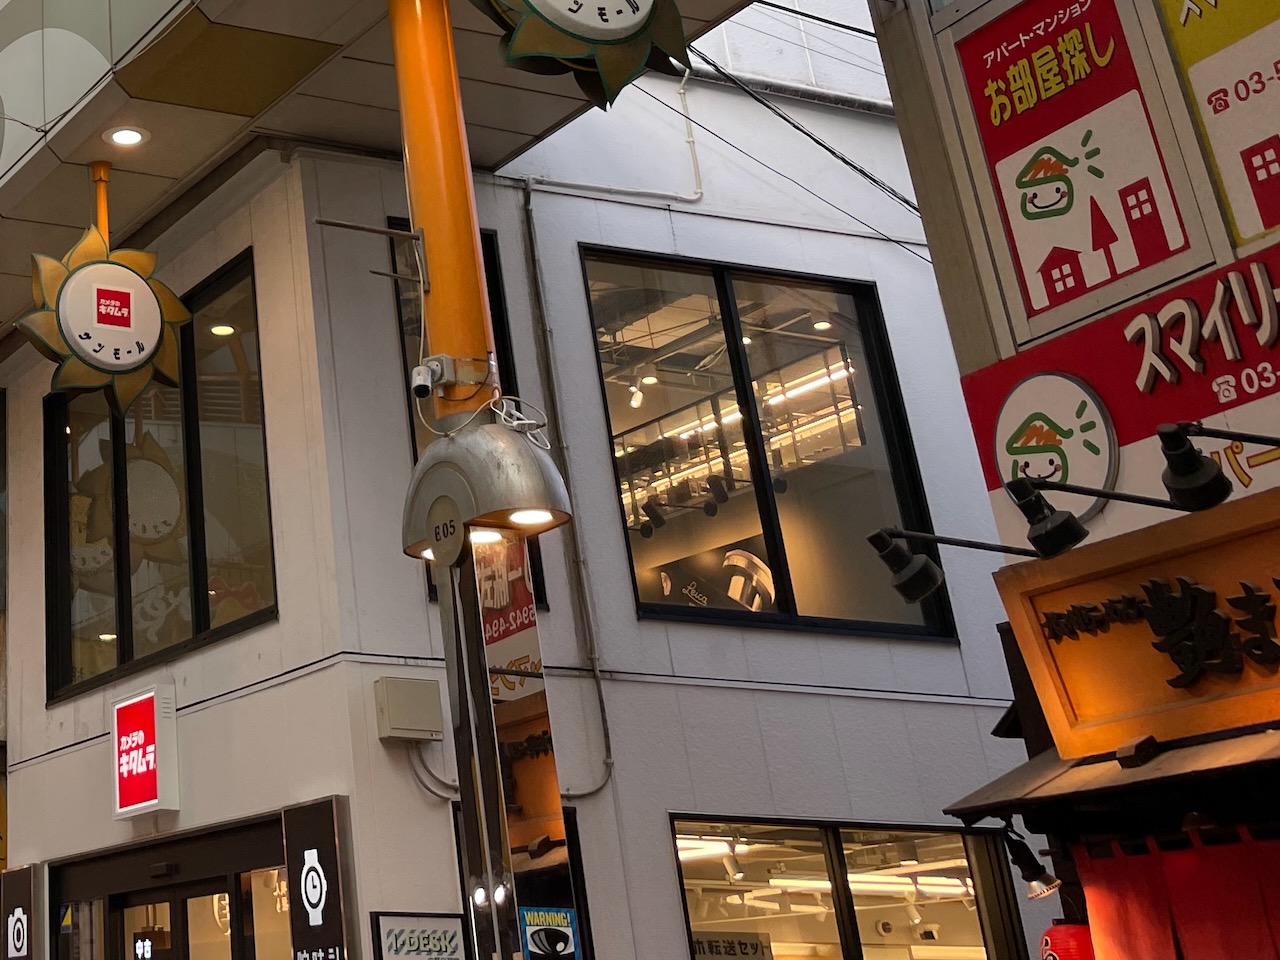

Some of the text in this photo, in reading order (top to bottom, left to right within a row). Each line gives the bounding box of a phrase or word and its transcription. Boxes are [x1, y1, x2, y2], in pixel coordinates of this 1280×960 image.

[983, 22, 1115, 126] お部屋探し
[99, 305, 129, 317] キタムラ
[1123, 262, 1280, 393] スマイリ
[78, 331, 145, 360] サンモール
[682, 581, 708, 607] Leica
[120, 730, 145, 751] カメラの
[119, 744, 156, 778] キタムラ
[524, 911, 571, 927] WARNING!
